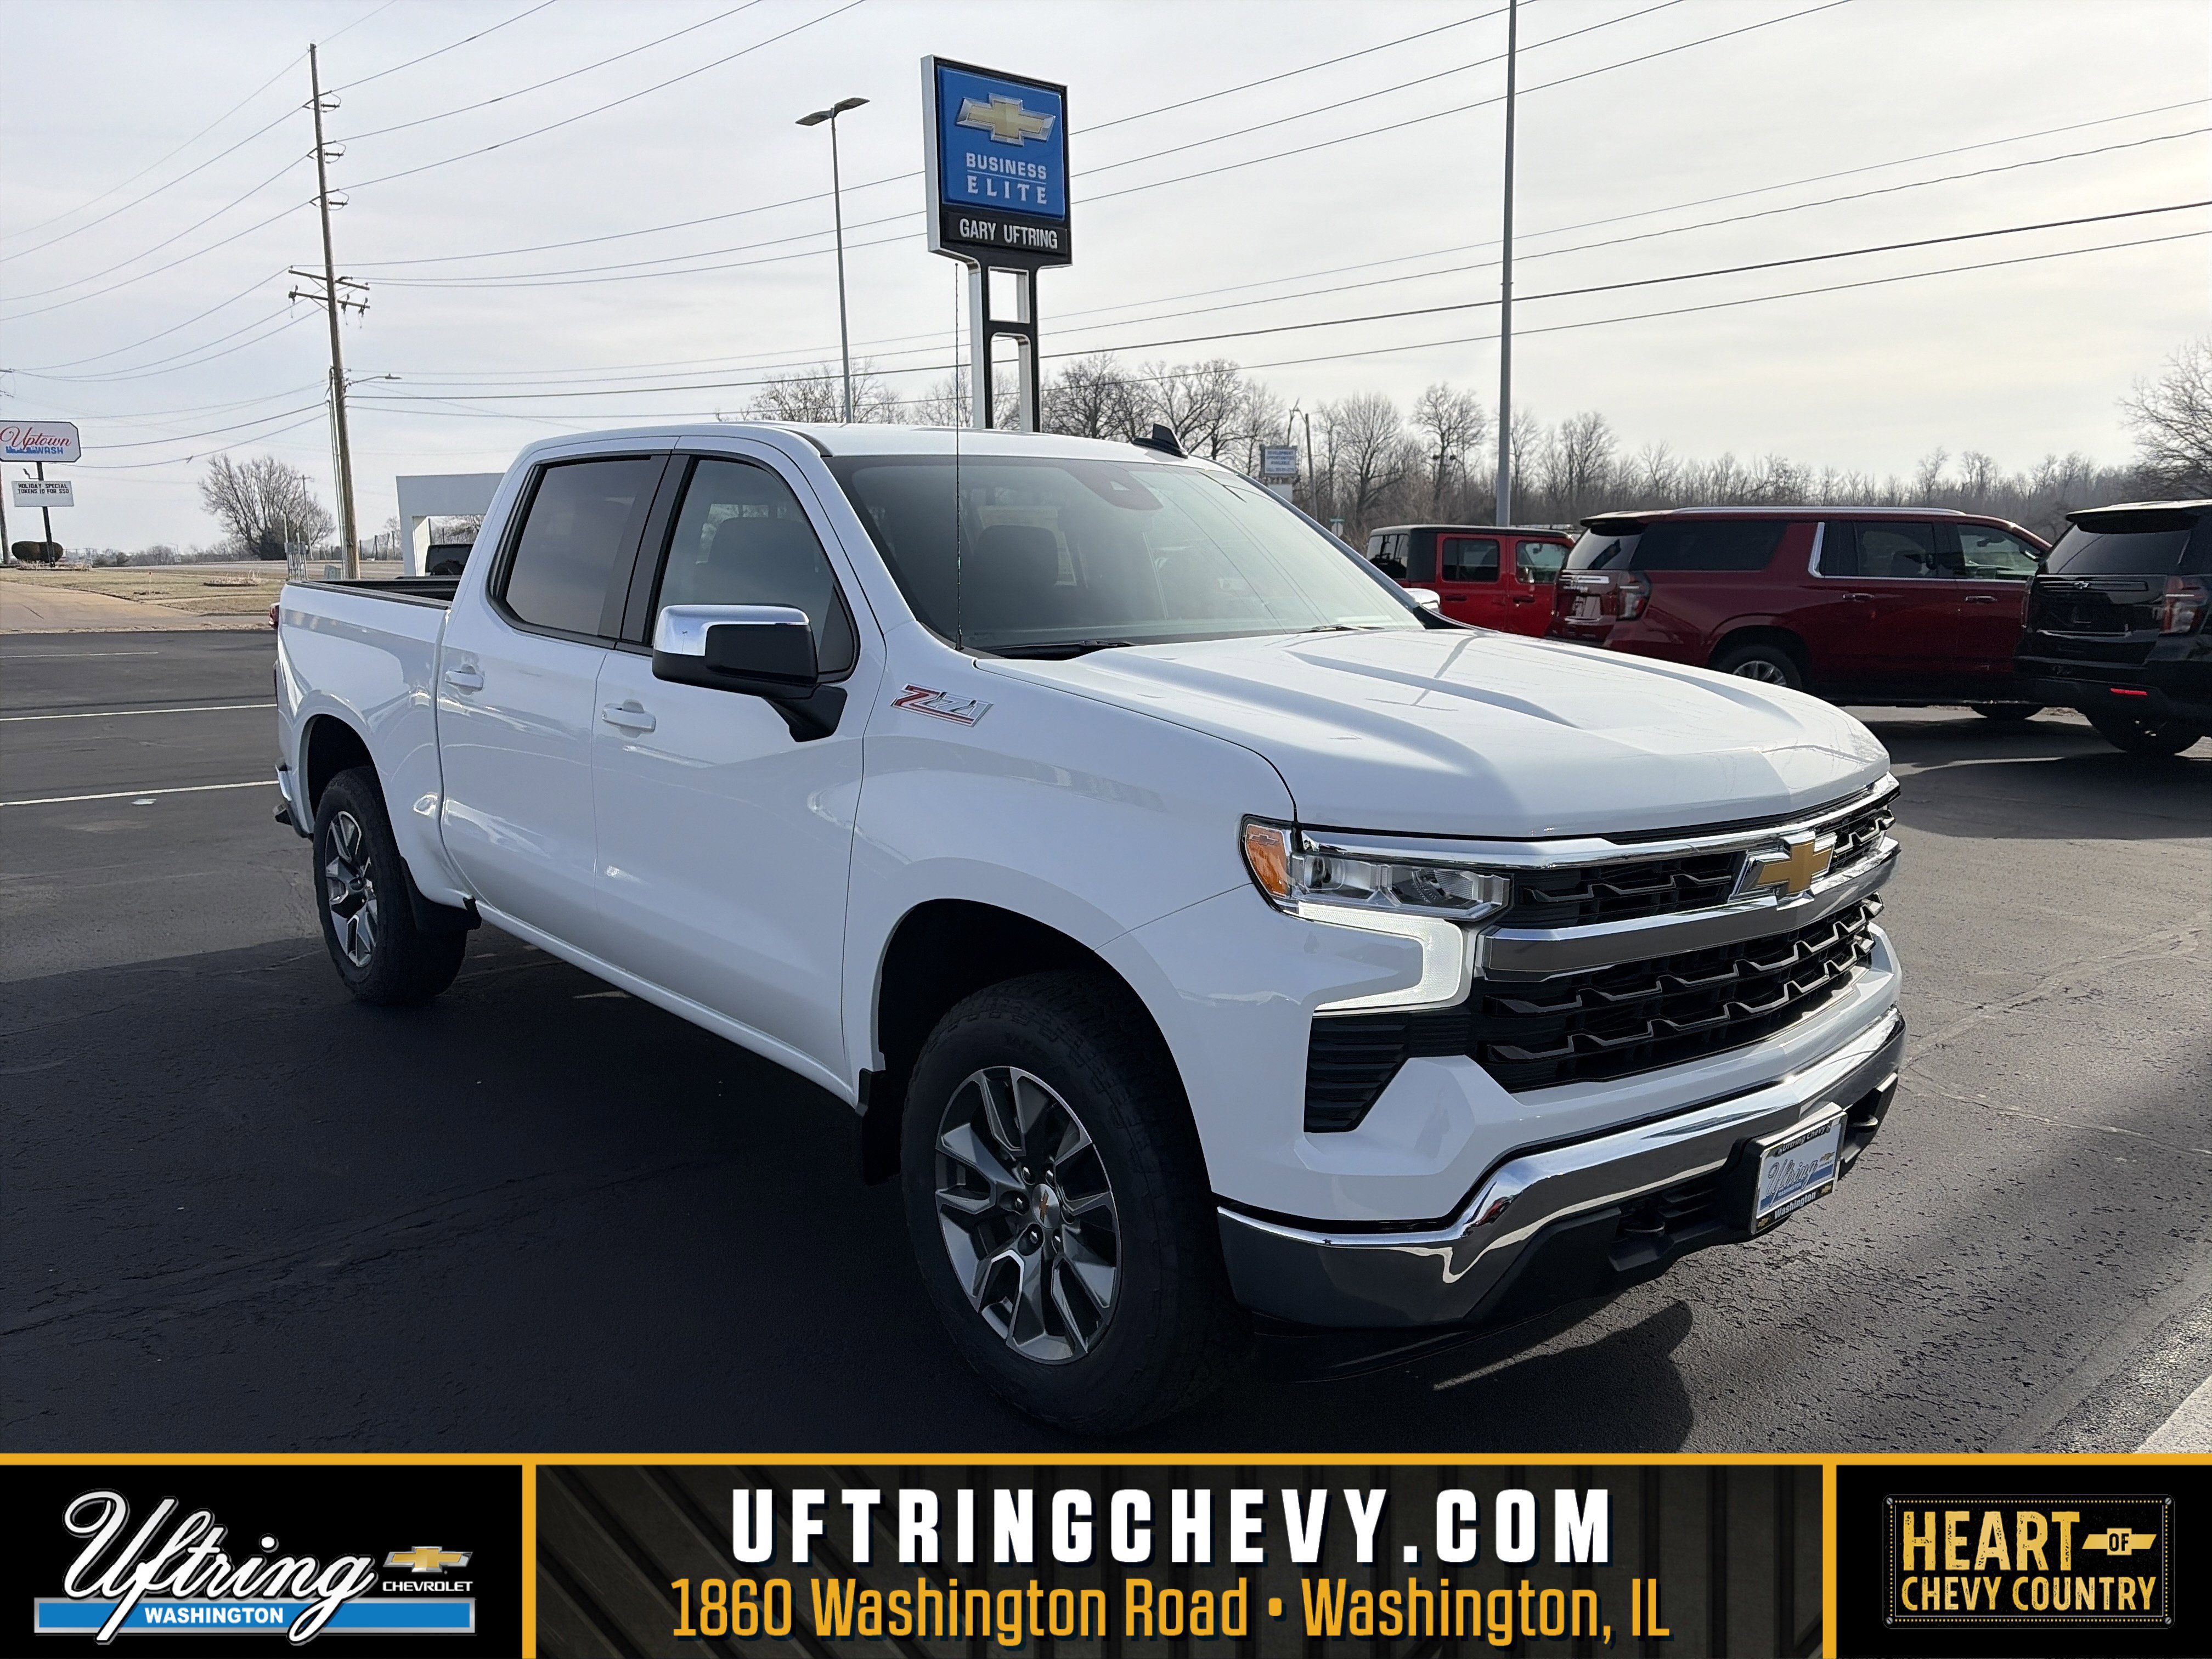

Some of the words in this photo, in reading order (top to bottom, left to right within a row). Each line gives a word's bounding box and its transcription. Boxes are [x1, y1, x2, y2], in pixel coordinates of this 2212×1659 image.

[966, 152, 1047, 179] BUSINESS
[967, 176, 1047, 204] ELITE
[959, 218, 996, 241] GARY
[1003, 224, 1058, 249] UFTRING
[0, 426, 71, 449] Uptown
[35, 446, 64, 454] WASH
[890, 682, 994, 727] Z71
[1765, 1159, 1818, 1207] Uftring
[1774, 1191, 1816, 1220] Washington
